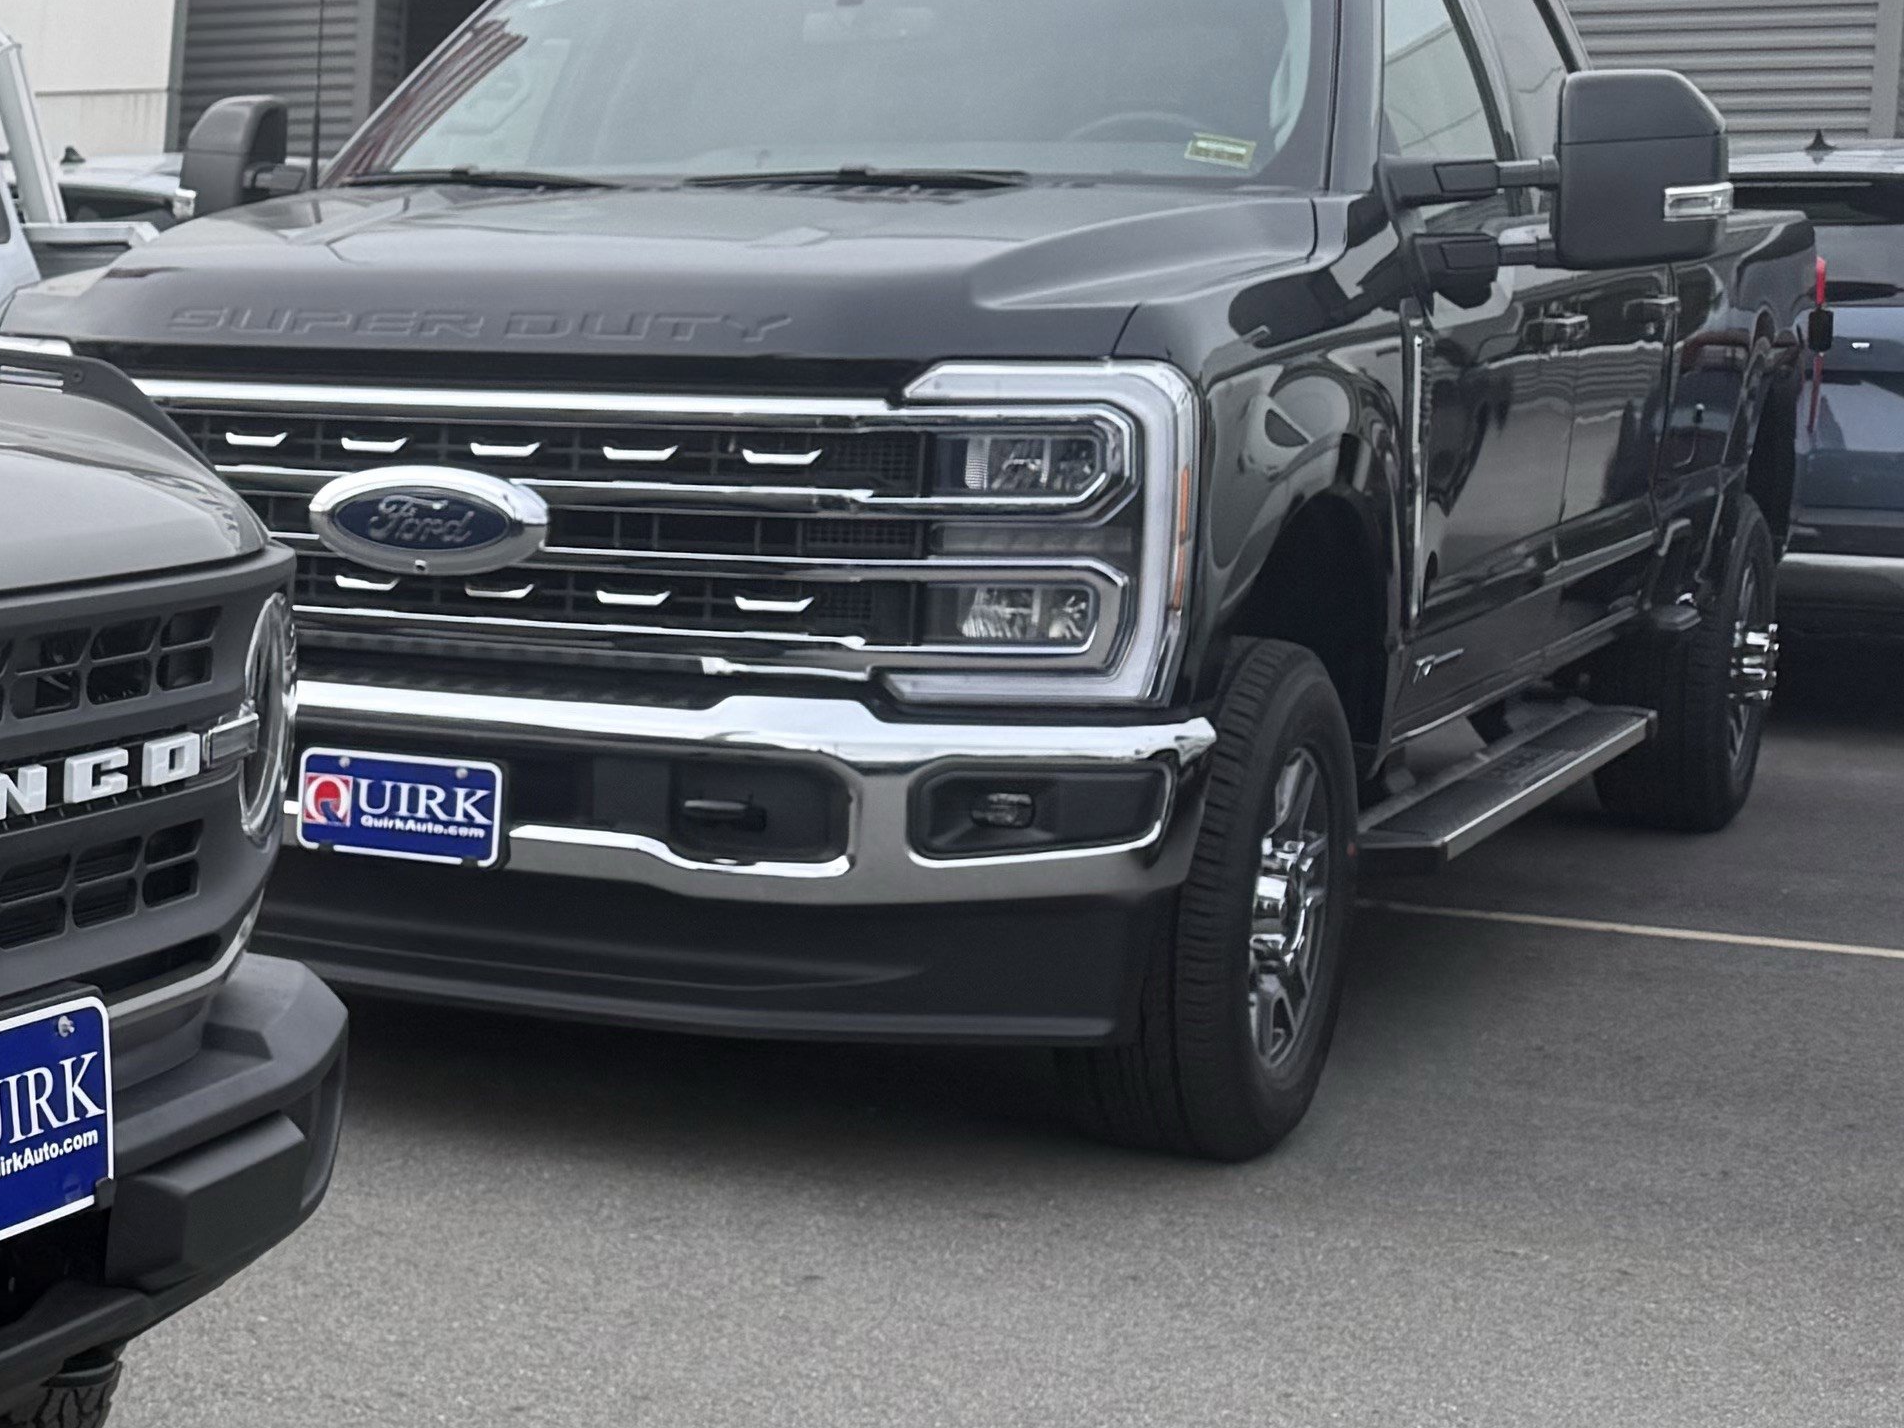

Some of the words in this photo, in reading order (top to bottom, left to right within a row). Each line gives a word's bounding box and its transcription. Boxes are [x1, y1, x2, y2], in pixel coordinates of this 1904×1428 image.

[167, 306, 486, 343] SUPER
[504, 309, 796, 344] DUTY
[370, 495, 472, 549] Ford
[304, 774, 493, 827] QUIRK
[360, 814, 486, 839] QuirkAuto.com
